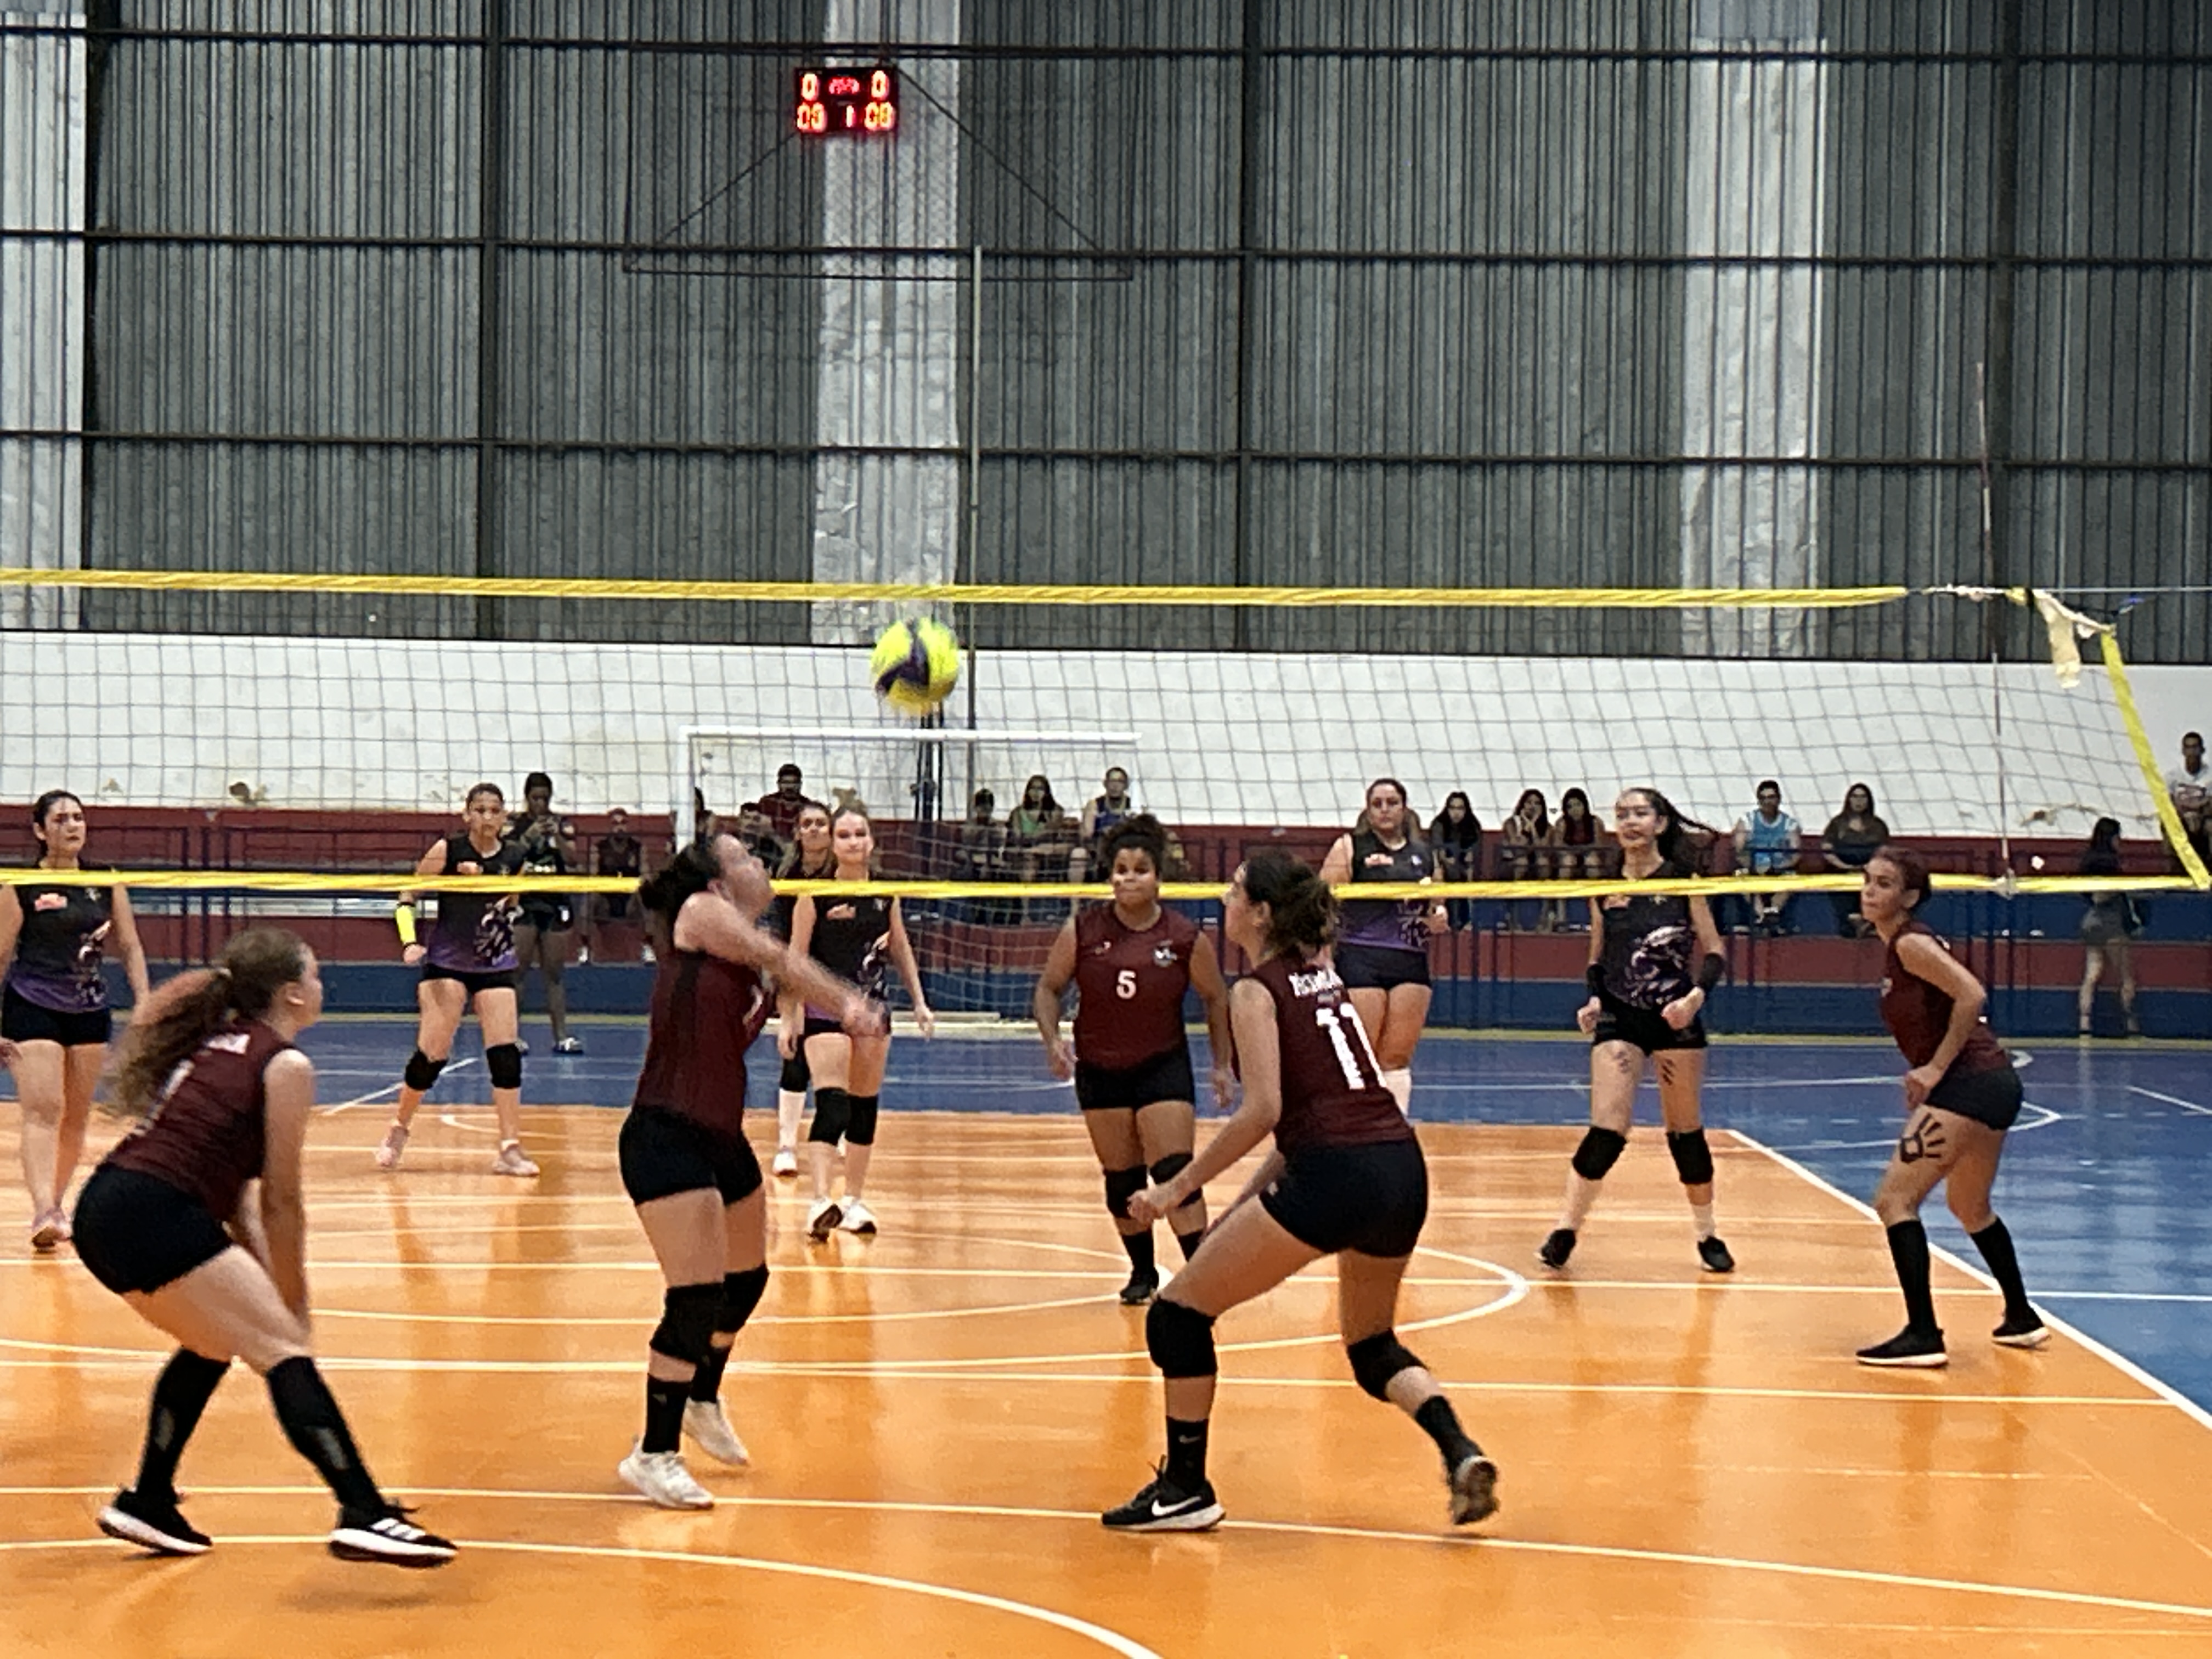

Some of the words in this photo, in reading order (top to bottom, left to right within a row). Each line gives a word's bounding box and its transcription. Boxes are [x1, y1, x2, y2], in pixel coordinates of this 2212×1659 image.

[845, 105, 855, 128] 1
[1116, 970, 1137, 1000] 5
[1316, 1002, 1387, 1090] 11
